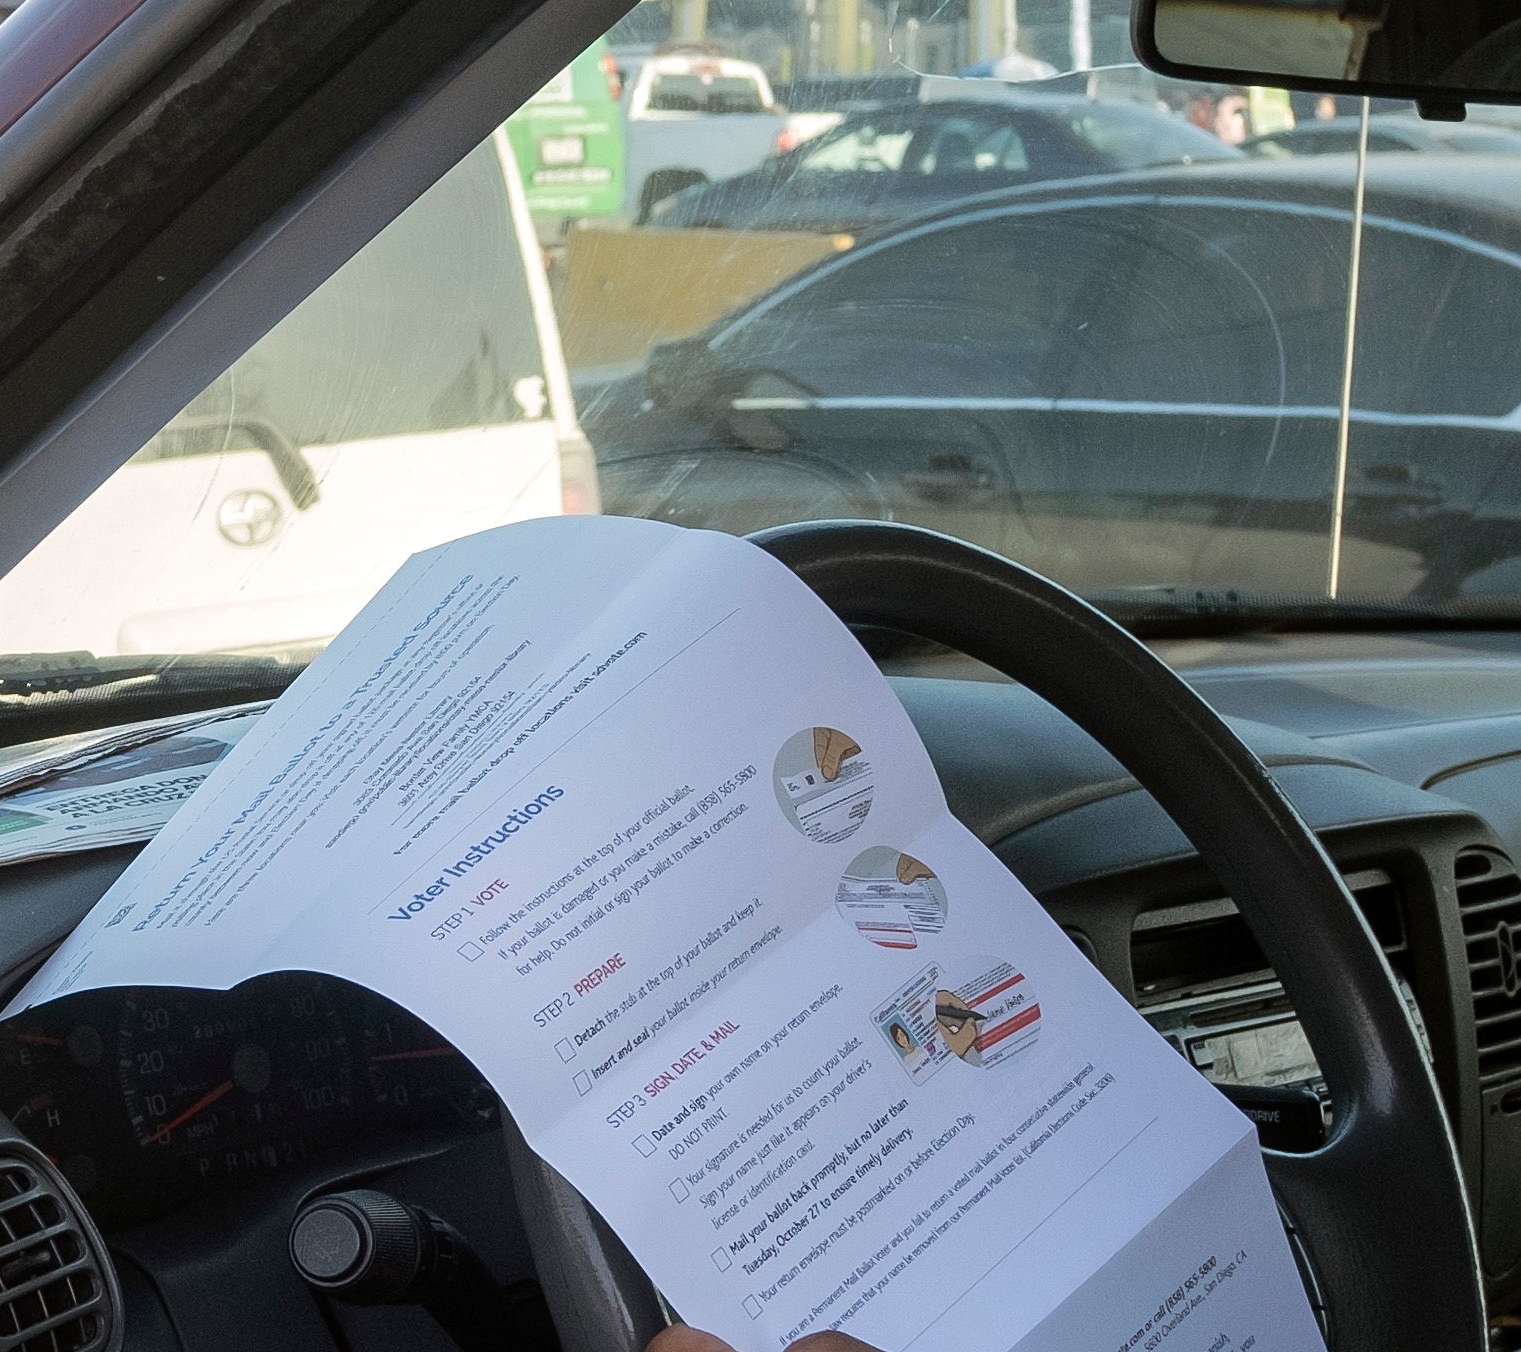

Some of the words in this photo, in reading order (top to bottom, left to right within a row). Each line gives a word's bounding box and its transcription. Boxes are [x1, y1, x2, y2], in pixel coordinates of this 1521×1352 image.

[387, 877, 450, 920] Voter
[444, 785, 564, 877] Instructions
[430, 912, 463, 941] STEP
[460, 906, 475, 917] 1
[469, 878, 509, 906] VOTE
[478, 920, 511, 945] Follow
[507, 909, 527, 924] the
[522, 872, 575, 912] instructions
[572, 864, 586, 876] at
[581, 853, 600, 868] the
[595, 842, 615, 858] top
[612, 832, 625, 847] of
[621, 820, 643, 843] your
[641, 798, 671, 825] official
[497, 948, 509, 960] If
[507, 935, 529, 957] your
[524, 916, 555, 939] ballot
[597, 874, 610, 887] or
[607, 863, 627, 883] you
[623, 847, 649, 868] make
[645, 841, 655, 852] a
[683, 805, 701, 823] call
[695, 790, 722, 815] (858)
[717, 764, 757, 798] 565-5800
[532, 998, 563, 1028] STEP
[561, 991, 575, 1007] 2
[573, 952, 626, 997] PREPARE
[573, 1017, 605, 1047] Detach
[604, 1008, 620, 1024] the
[618, 992, 637, 1013] stub
[637, 985, 647, 1000] at
[645, 976, 661, 992] the
[659, 965, 675, 981] top
[673, 954, 684, 971] of
[681, 944, 701, 968] your
[698, 927, 723, 950] ballot
[721, 914, 737, 933] and
[605, 1100, 635, 1129] STEP
[632, 1093, 647, 1107] 3
[699, 1039, 716, 1052] &
[708, 1020, 740, 1045] MAIL
[650, 1121, 676, 1142] Date
[672, 1105, 692, 1125] and
[688, 1094, 709, 1112] sign
[704, 1078, 725, 1102] your
[723, 1065, 743, 1084] own
[739, 1049, 763, 1071] name
[759, 1040, 774, 1053] on
[769, 1025, 789, 1048] your
[786, 1008, 811, 1031] return
[698, 1189, 720, 1209] Sign
[716, 1173, 736, 1199] your
[734, 1156, 758, 1180] name
[755, 1142, 773, 1165] just
[768, 1132, 786, 1149] like
[782, 1125, 794, 1137] it
[791, 1103, 821, 1131] appears
[818, 1094, 832, 1108] on
[827, 1079, 846, 1103] your
[845, 1058, 872, 1085] driver's
[667, 1142, 686, 1161] DO
[681, 1126, 704, 1149] NOT
[710, 1203, 740, 1230] license
[738, 1194, 749, 1208] or
[746, 1155, 797, 1200] identification
[728, 1232, 751, 1256] Mail
[747, 1218, 768, 1244] your
[765, 1197, 793, 1223] ballot
[789, 1181, 812, 1203] back
[843, 1137, 862, 1155] but
[859, 1129, 873, 1144] no
[868, 1113, 890, 1134] later
[887, 1098, 909, 1118] than
[741, 1243, 780, 1275] Tuesday,
[775, 1214, 810, 1247] October
[806, 1202, 821, 1220] 27
[818, 1197, 832, 1210] to
[829, 1174, 857, 1201] ensure
[854, 1152, 883, 1179] timely
[880, 1127, 914, 1157] delivery.
